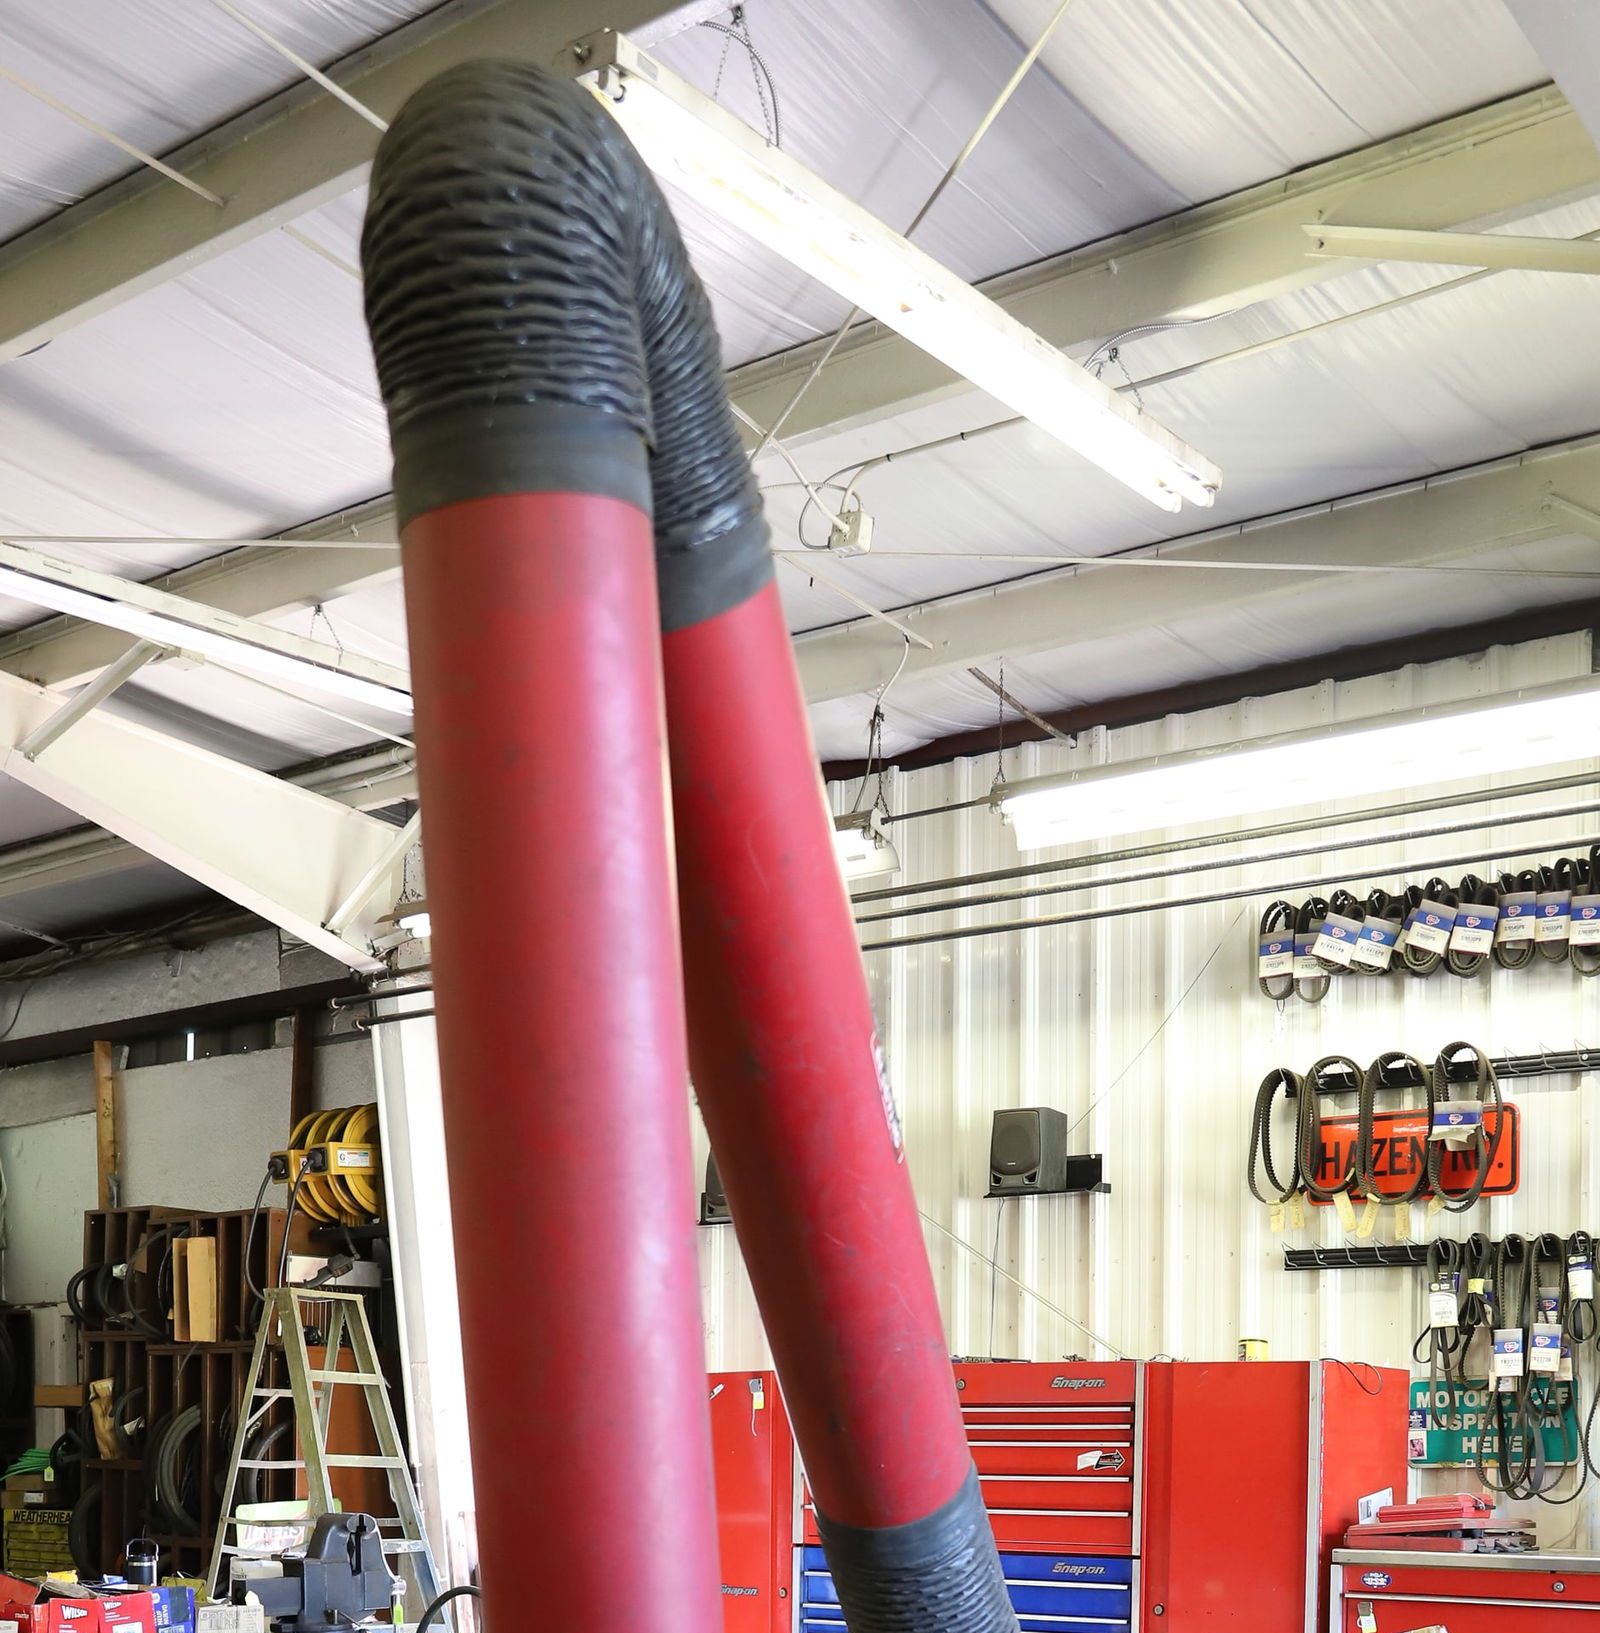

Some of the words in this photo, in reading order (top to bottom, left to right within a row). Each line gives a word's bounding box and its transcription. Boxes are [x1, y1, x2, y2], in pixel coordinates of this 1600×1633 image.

[1320, 1134, 1429, 1180] HAZEN
[1051, 1377, 1105, 1390] Snap-on
[1052, 1562, 1106, 1576] Snap-on
[61, 1605, 88, 1620] WILSON
